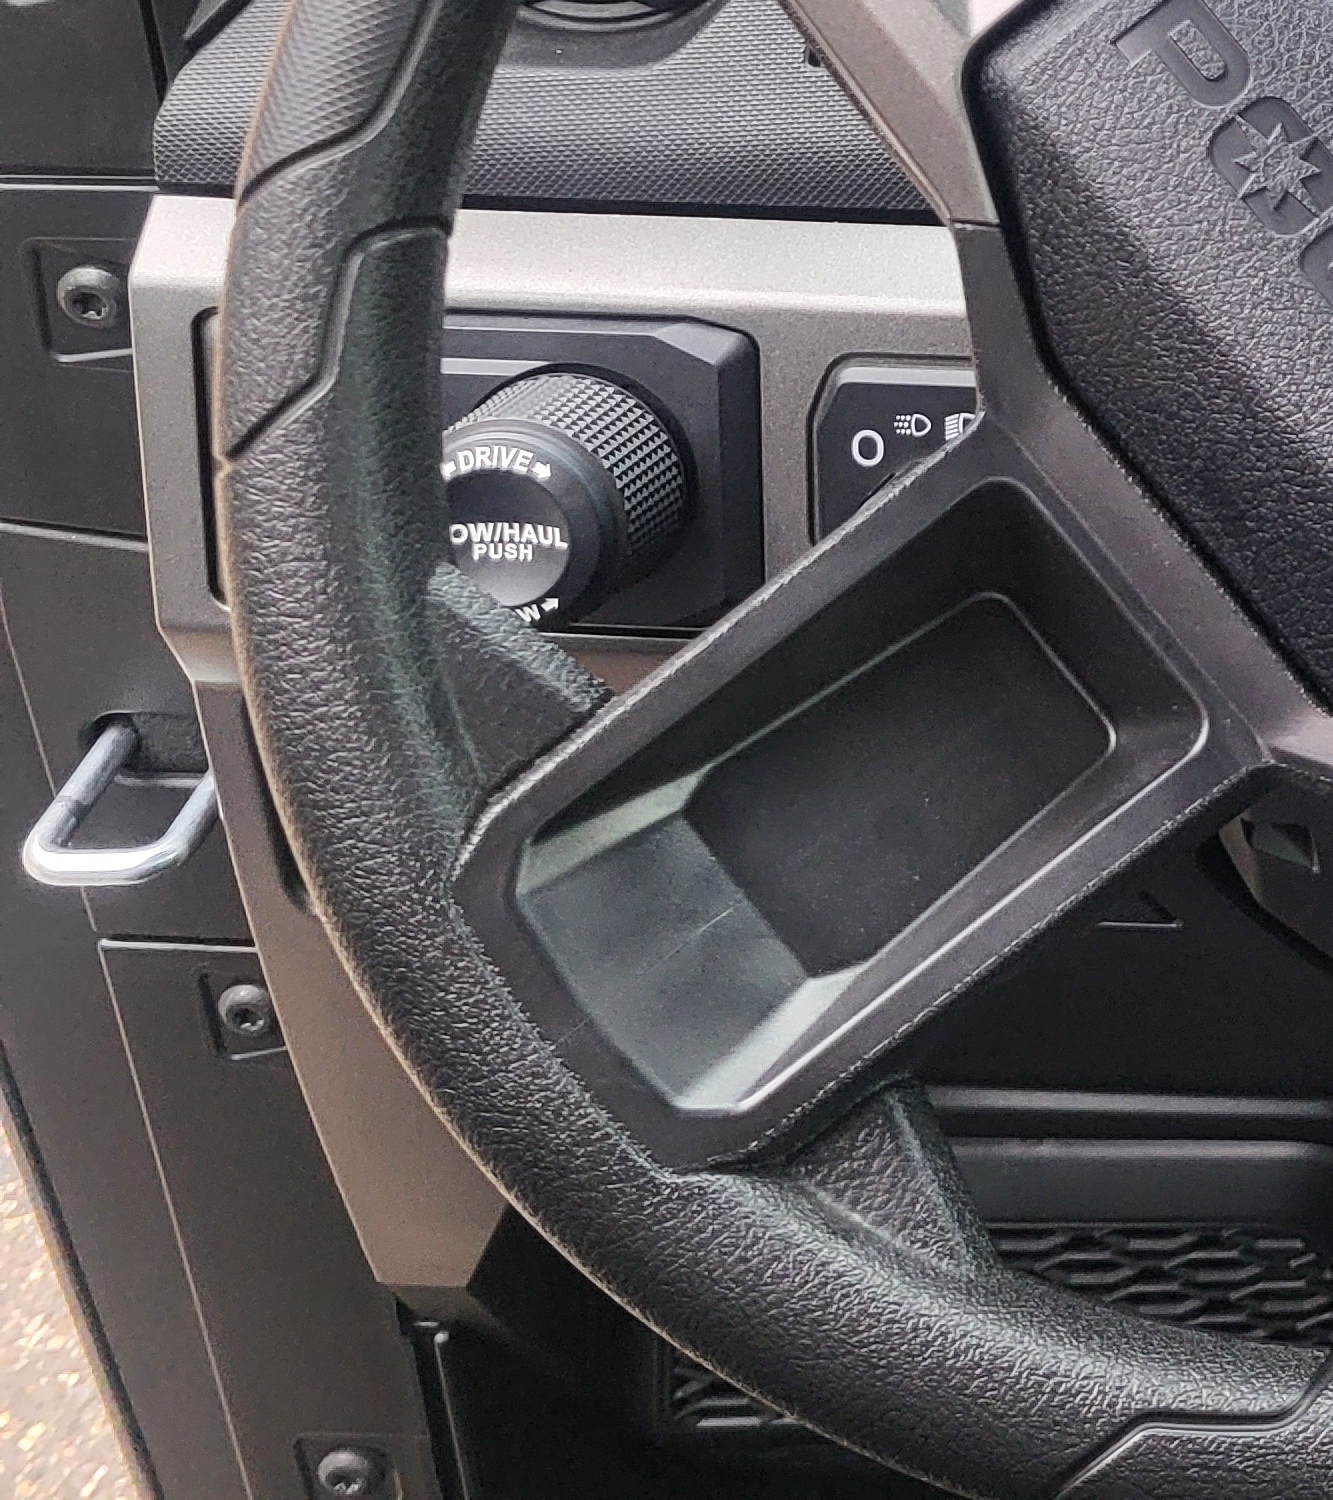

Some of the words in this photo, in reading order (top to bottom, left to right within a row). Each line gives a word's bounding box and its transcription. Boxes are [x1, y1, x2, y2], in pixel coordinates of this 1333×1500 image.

[457, 444, 535, 475] DRIVE
[449, 521, 569, 550] OW/HAUL
[472, 542, 533, 562] PUSH
